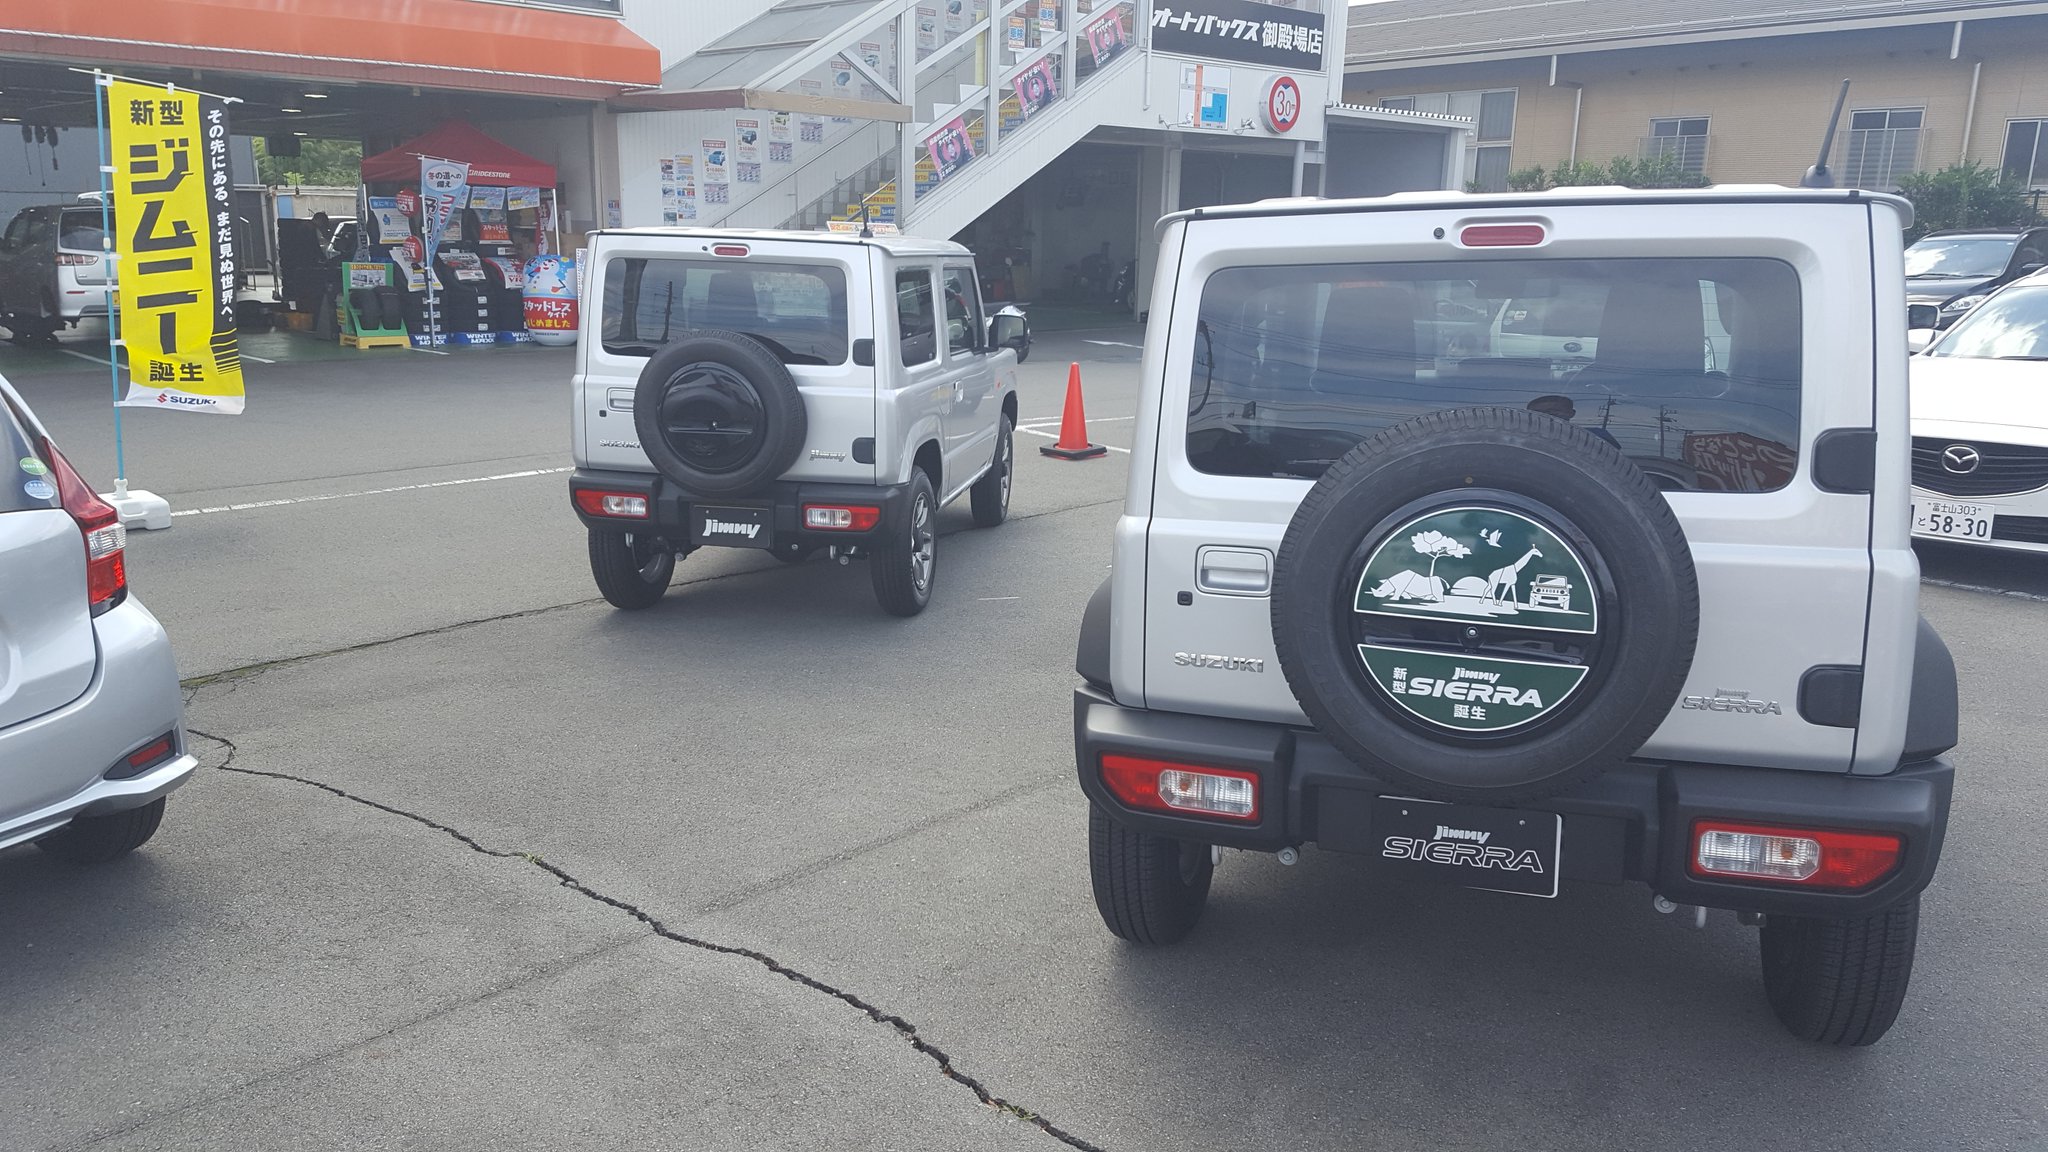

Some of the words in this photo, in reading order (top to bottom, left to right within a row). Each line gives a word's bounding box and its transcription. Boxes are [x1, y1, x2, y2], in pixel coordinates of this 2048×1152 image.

[1152, 7, 1260, 42] オートバックス
[1262, 20, 1323, 55] 御殿場店
[129, 99, 185, 126] 新型
[428, 171, 462, 180] 冬の道への
[468, 169, 511, 179] BRIDGESTONE
[206, 108, 234, 322] その先にある、まだ見ぬ世界へ。
[128, 137, 204, 355] ジムニー
[523, 300, 571, 312] スタッドレス
[527, 318, 571, 328] じめました
[149, 360, 204, 382] 誕生
[809, 449, 848, 462] Jimny
[1932, 502, 1977, 516] 富士山303
[702, 519, 761, 539] Jimny
[1918, 517, 1926, 527] と
[1930, 514, 1988, 538] 58-30
[1174, 651, 1264, 673] SUZUKI
[1391, 667, 1408, 694] 新型
[1451, 667, 1501, 684] Jimny
[1408, 677, 1544, 709] SIERRA
[1453, 703, 1487, 721] 誕生
[1682, 695, 1782, 716] SIERRA
[1433, 825, 1491, 844] Jimny
[1382, 836, 1544, 874] SIERRA
